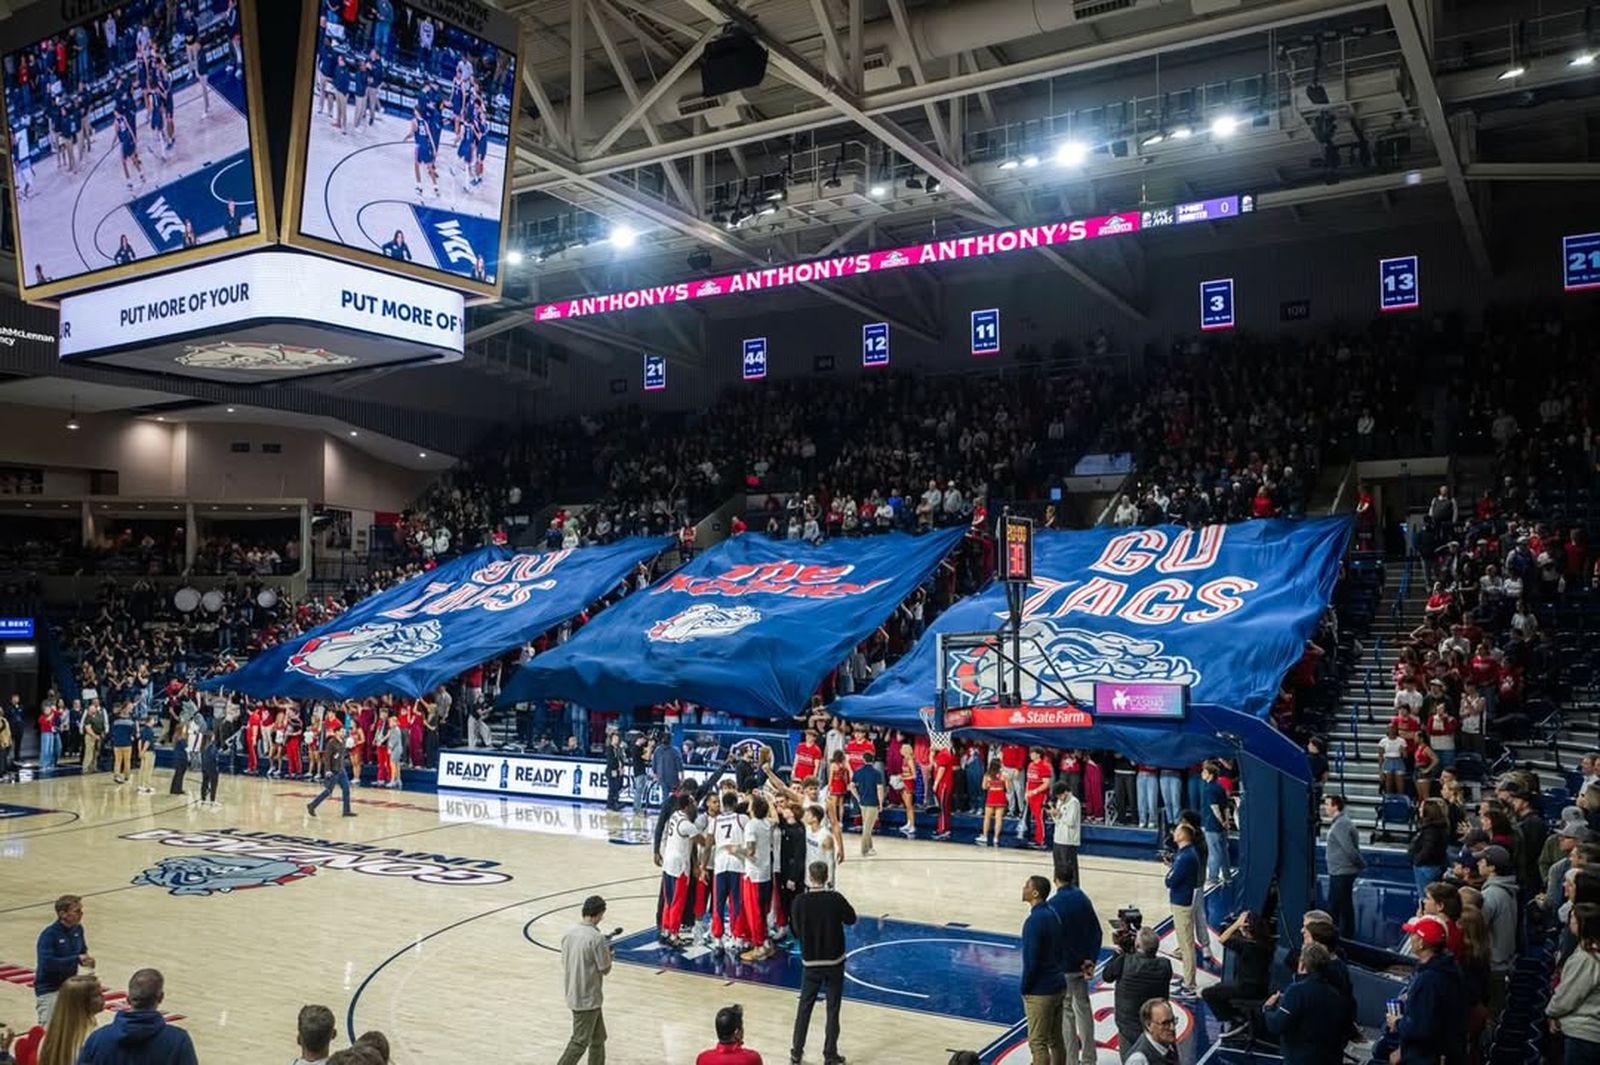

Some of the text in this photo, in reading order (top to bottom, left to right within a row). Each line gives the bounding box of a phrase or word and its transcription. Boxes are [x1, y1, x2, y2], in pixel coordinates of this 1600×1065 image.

[919, 220, 1087, 264] ANTHONY'S
[729, 254, 871, 293] ANTHONY'S
[1384, 273, 1414, 291] 13
[120, 282, 250, 326] PUT MORE OF YOUR
[568, 284, 689, 318] ANTHONY'S
[1210, 295, 1224, 311] 3
[341, 289, 378, 314] PUT
[382, 299, 433, 327] MORE
[436, 312, 458, 332] OF
[976, 323, 995, 339] 11
[865, 336, 887, 351] 12
[744, 351, 764, 365] 44
[647, 363, 663, 376] 21
[1089, 524, 1227, 576] GU
[994, 576, 1259, 625] ZAGS
[1027, 710, 1085, 723] State Farm
[446, 761, 491, 778] READY
[515, 766, 564, 784] READY
[720, 823, 732, 839] 7
[119, 828, 513, 885] GONZAGA
